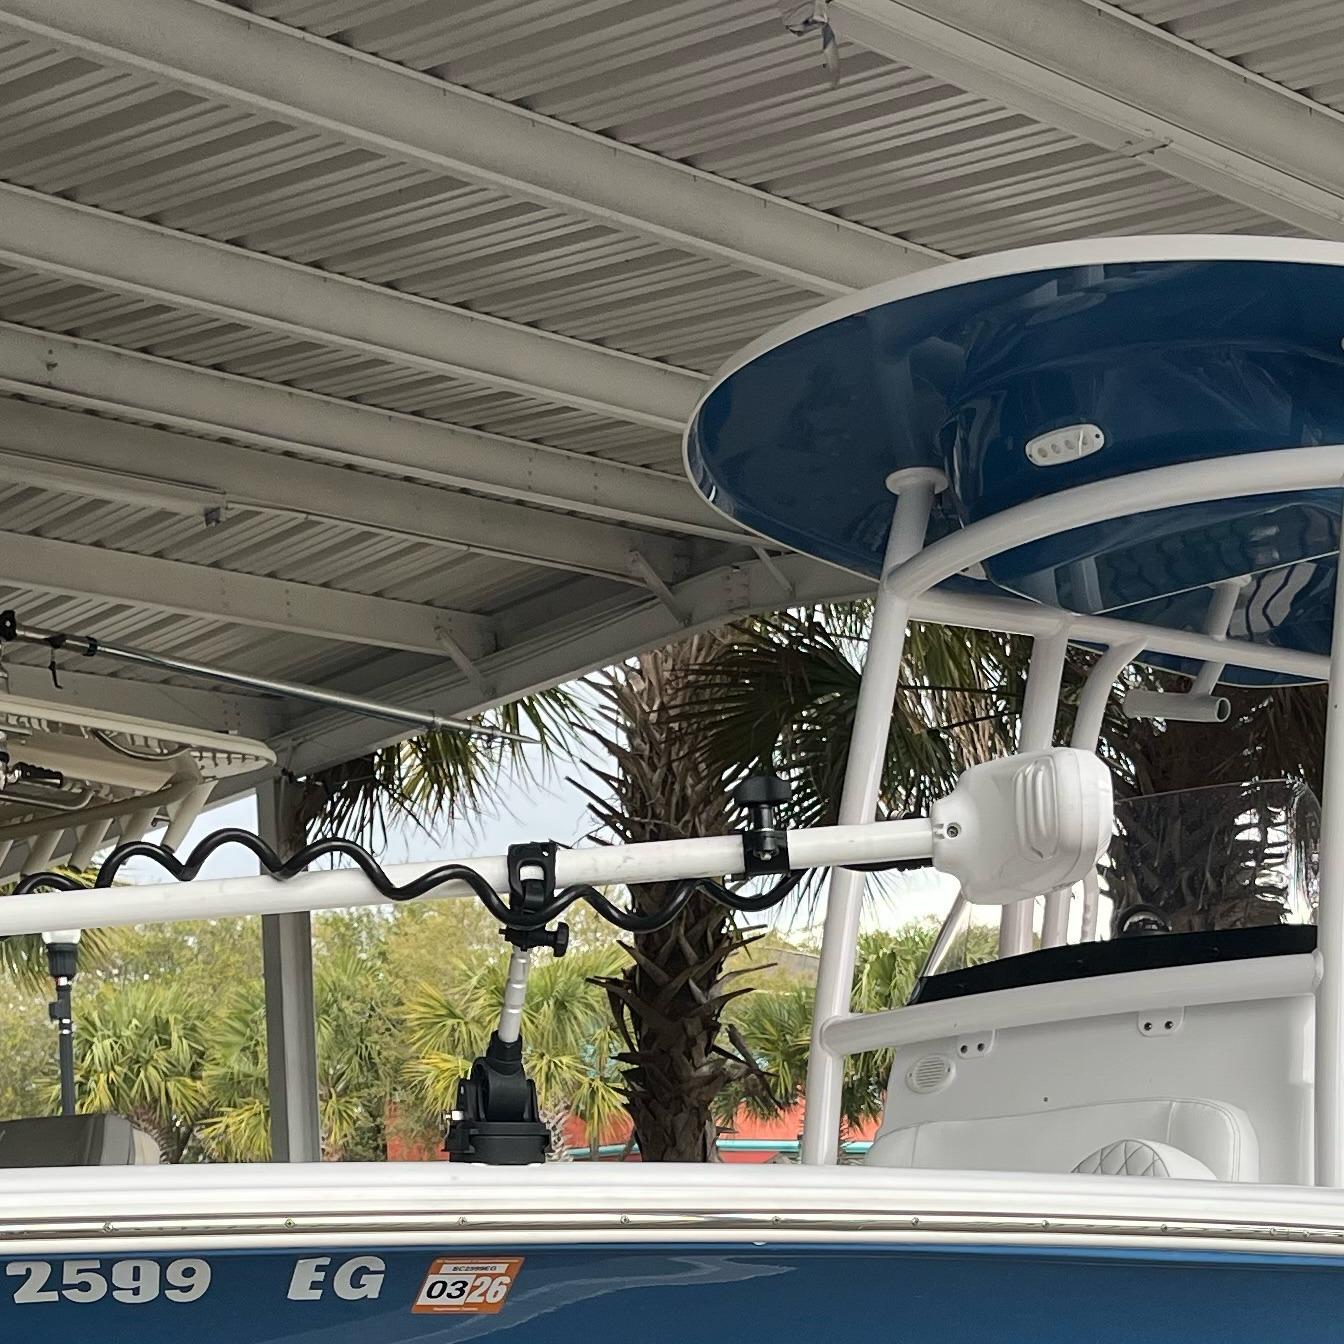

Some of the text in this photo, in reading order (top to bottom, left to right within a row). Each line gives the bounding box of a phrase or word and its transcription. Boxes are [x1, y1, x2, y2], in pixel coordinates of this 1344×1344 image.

[6, 1258, 212, 1305] 2599
[287, 1255, 386, 1301] EG
[426, 1276, 511, 1304] 03 26
